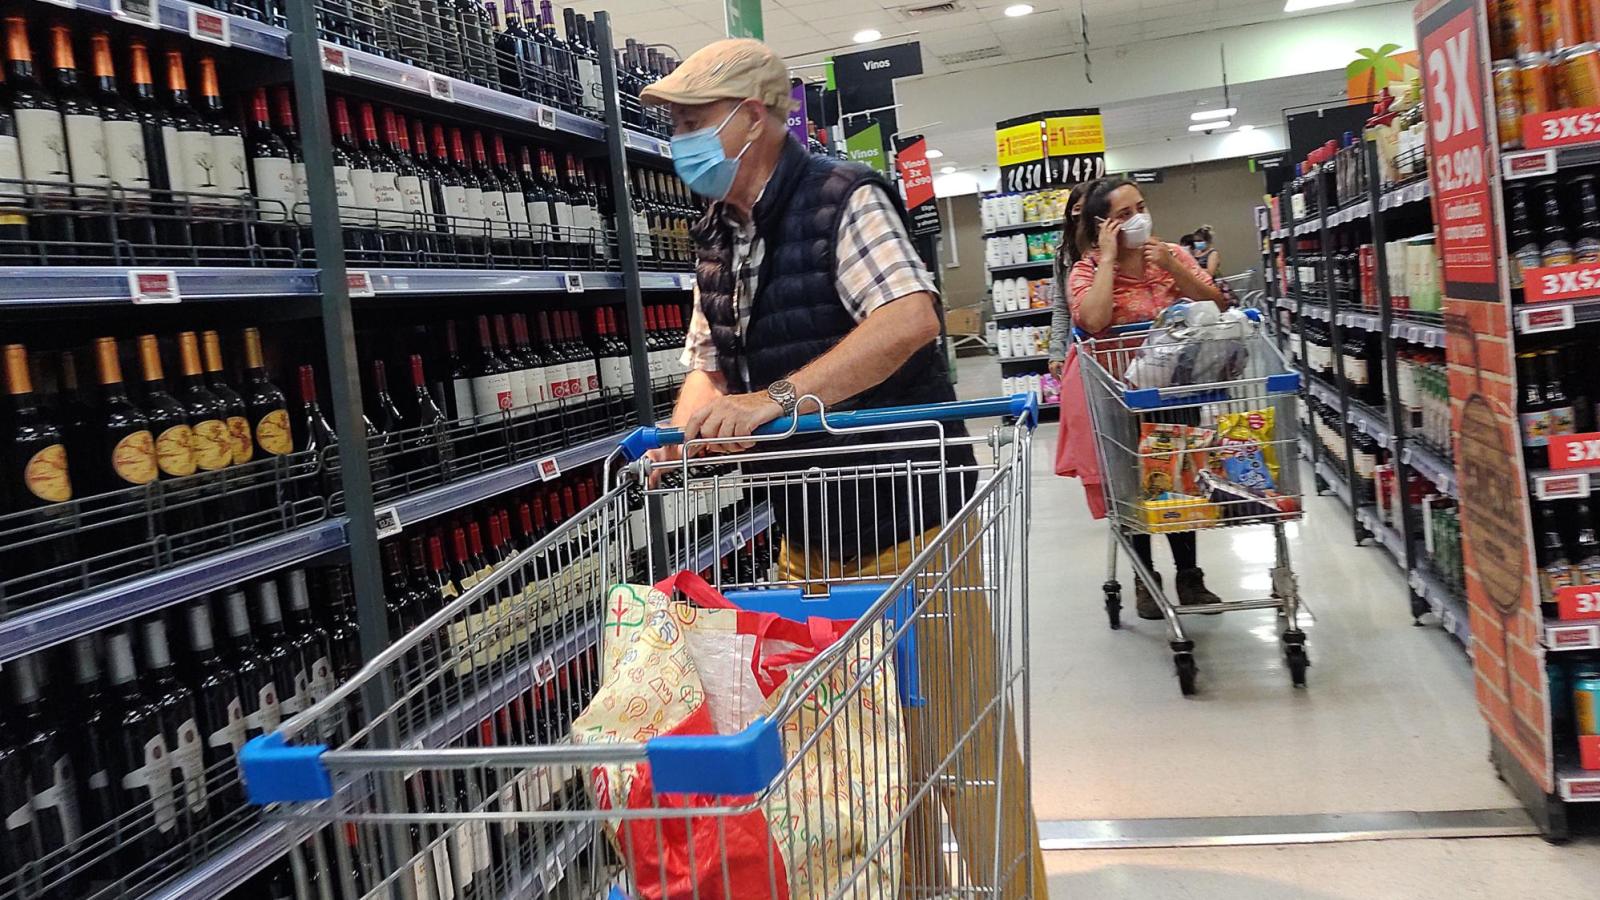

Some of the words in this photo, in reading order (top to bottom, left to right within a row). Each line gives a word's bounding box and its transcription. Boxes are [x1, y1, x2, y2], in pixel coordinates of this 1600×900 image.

[863, 58, 891, 71] Vinos
[1427, 27, 1479, 142] 3X
[850, 148, 880, 160] Vinos
[902, 159, 927, 169] Vinos
[1436, 145, 1483, 192] $2.990
